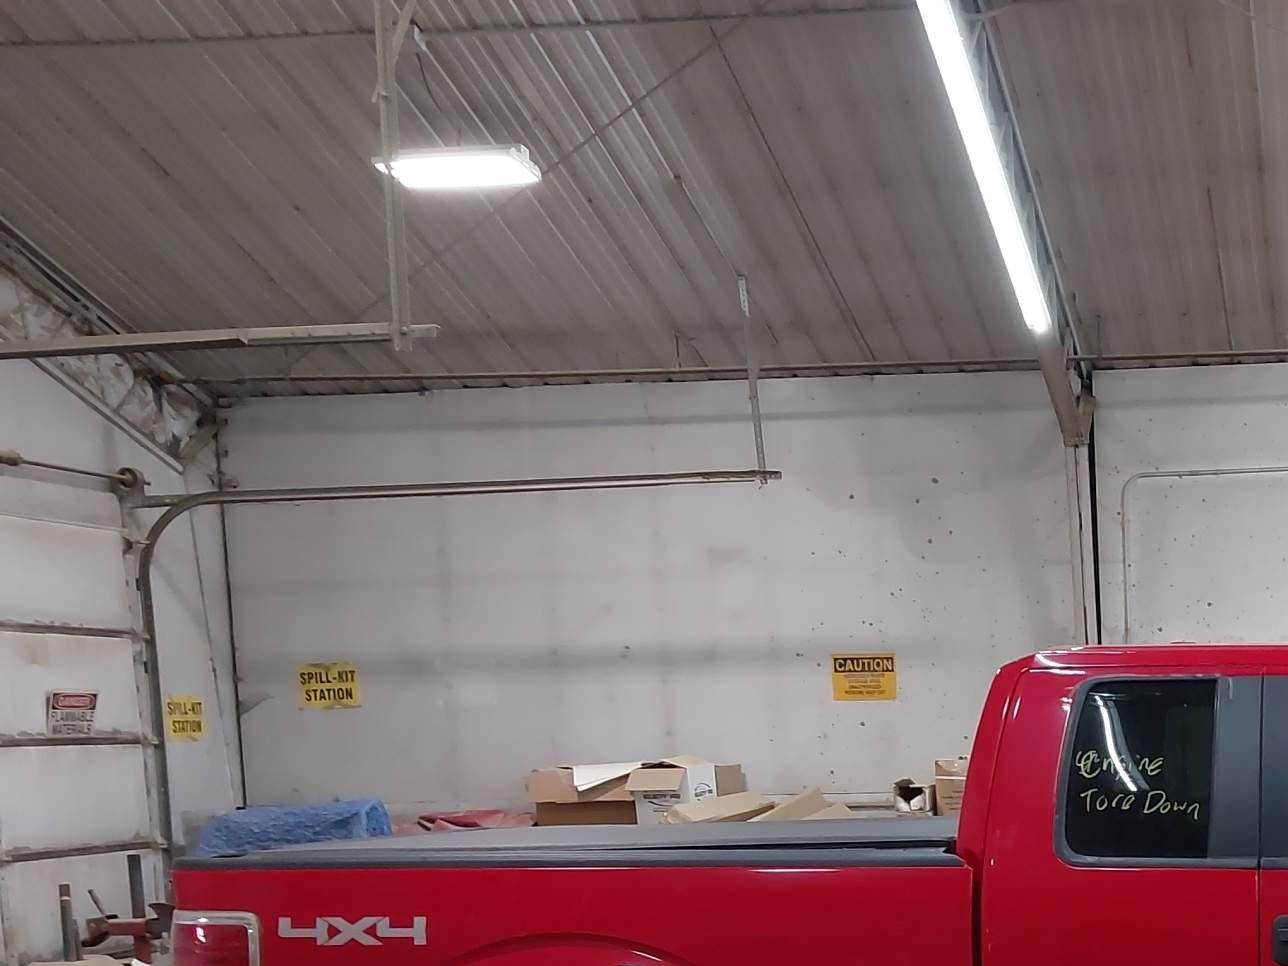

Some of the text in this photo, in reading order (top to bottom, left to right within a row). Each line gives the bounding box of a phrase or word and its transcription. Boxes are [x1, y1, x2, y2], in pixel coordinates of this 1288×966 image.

[835, 658, 893, 671] CAUTION
[299, 670, 356, 685] SPILL-KIT
[305, 687, 353, 701] STATION
[167, 702, 202, 715] SPILL-KIT
[172, 720, 202, 733] STATION
[1143, 790, 1200, 820] Down
